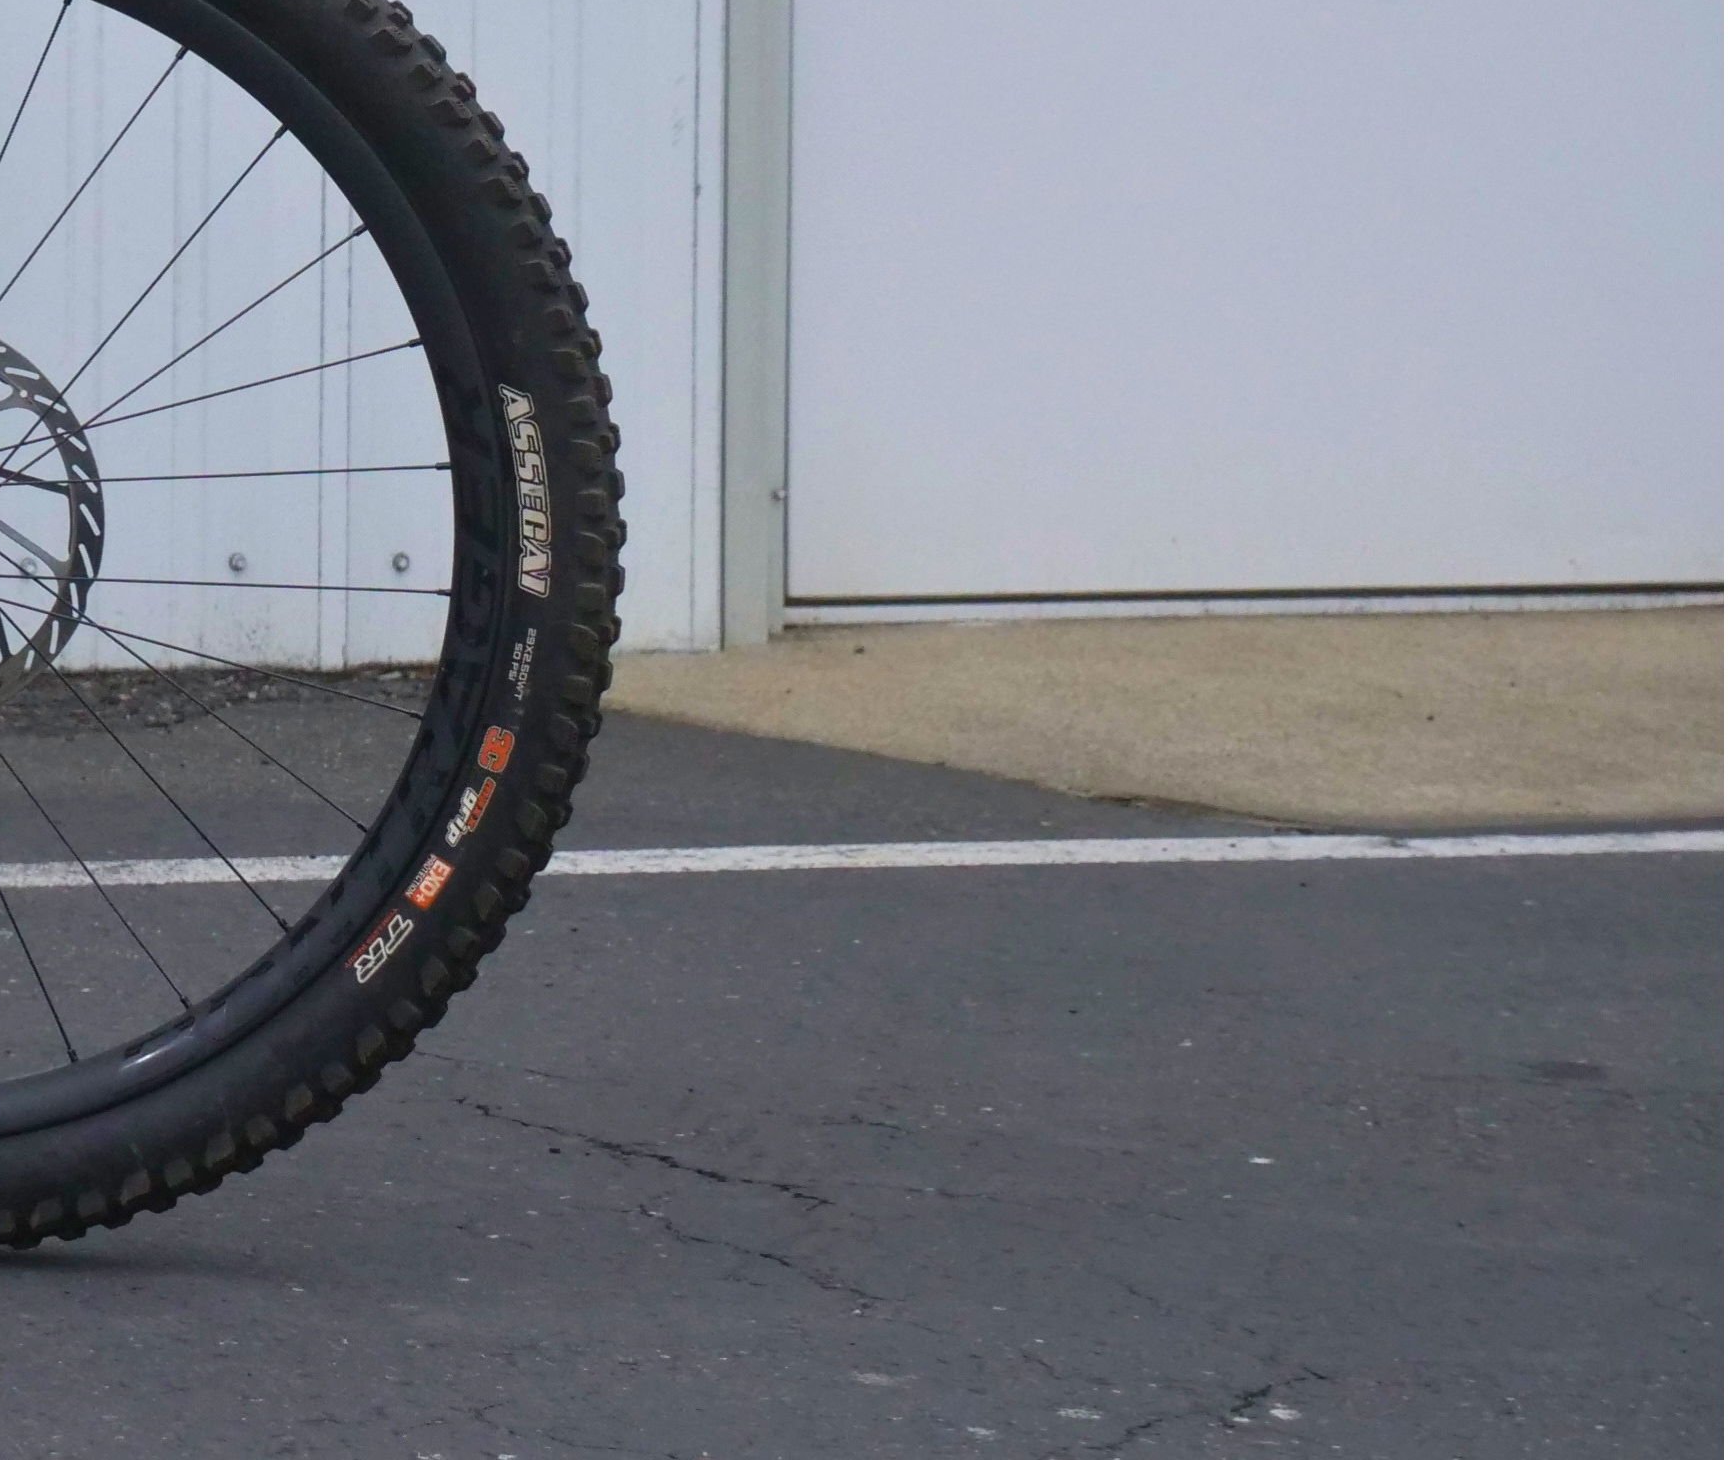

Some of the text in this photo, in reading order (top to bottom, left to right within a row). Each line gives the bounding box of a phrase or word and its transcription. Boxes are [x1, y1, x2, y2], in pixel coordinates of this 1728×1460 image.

[498, 384, 554, 599] ASSEGAI
[513, 642, 524, 660] 50
[513, 627, 537, 701] 29X2.50WT
[445, 786, 478, 847] grip
[354, 914, 414, 984] TR
